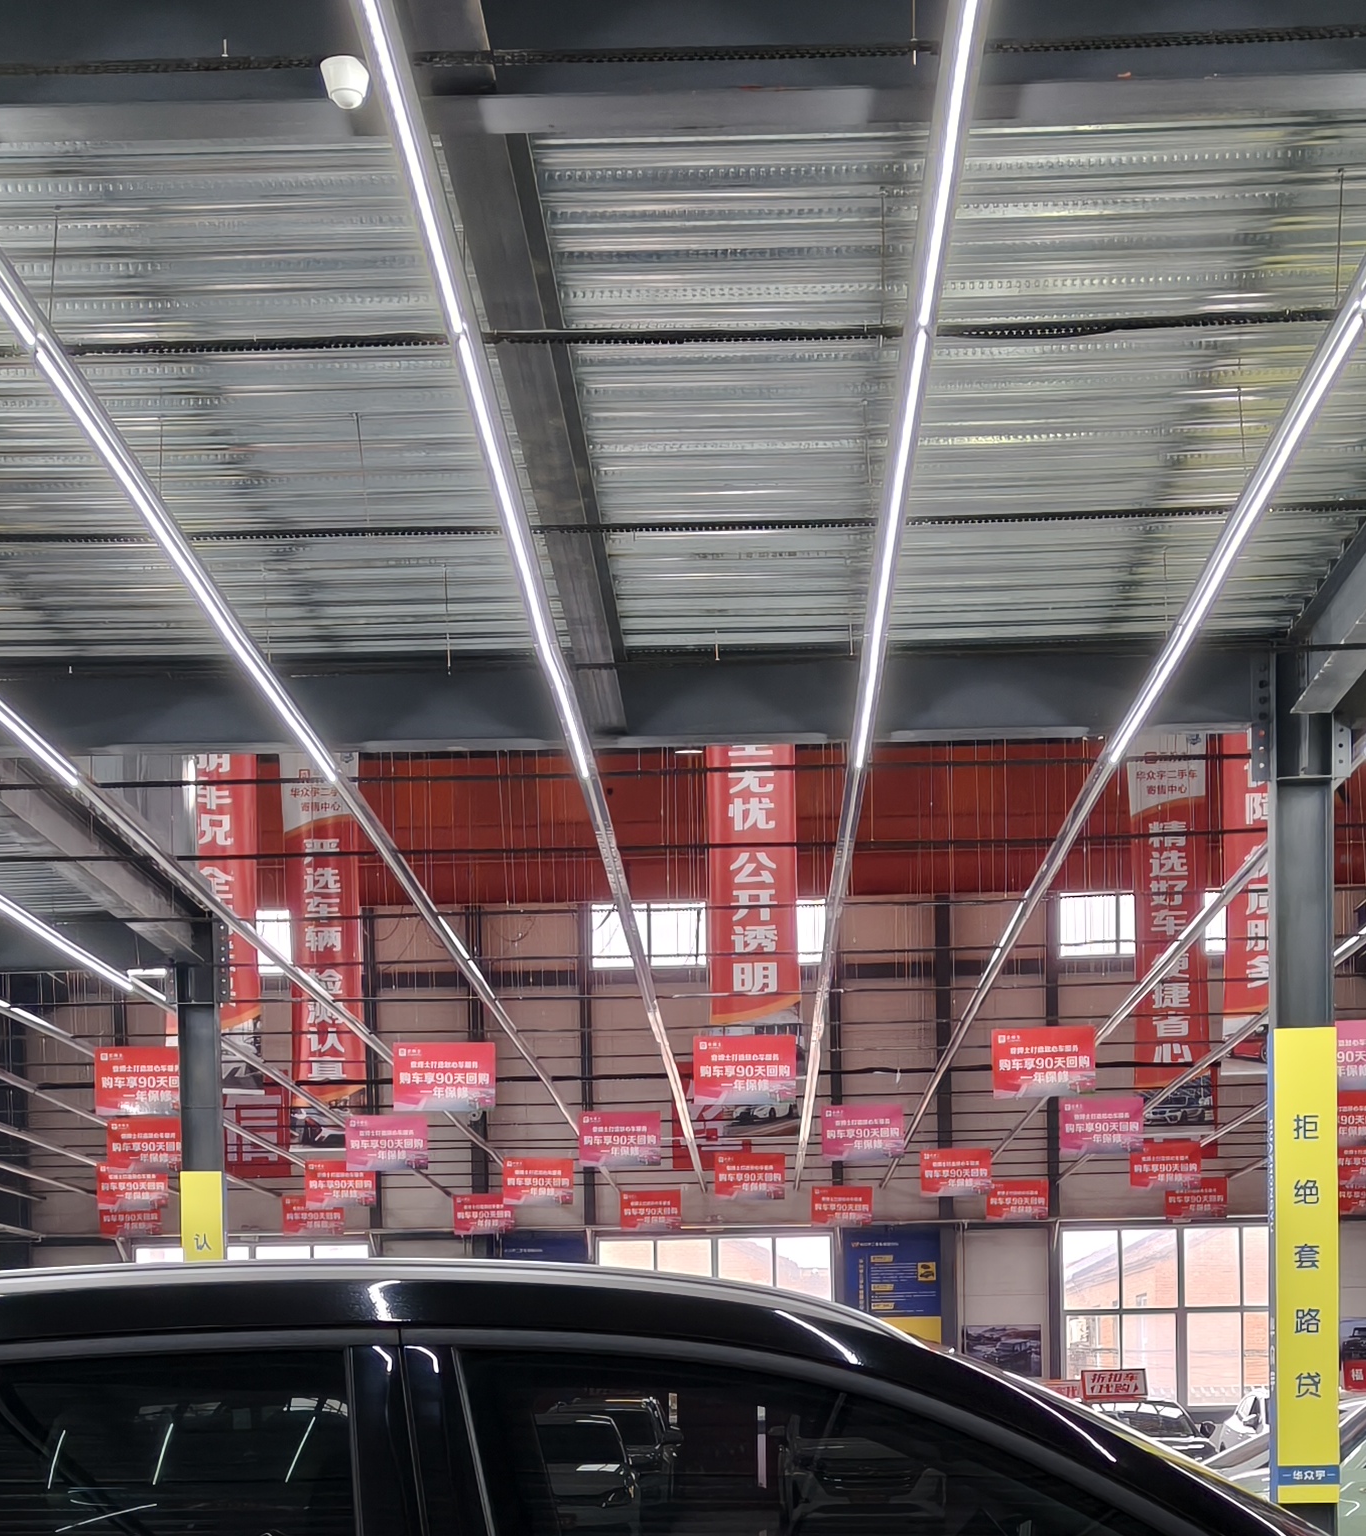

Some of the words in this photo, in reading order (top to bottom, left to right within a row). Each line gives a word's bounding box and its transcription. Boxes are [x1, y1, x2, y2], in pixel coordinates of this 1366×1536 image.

[1148, 820, 1189, 937] 精选好车
[998, 1055, 1090, 1071] 购车享90天回购
[699, 1065, 791, 1078] 购车享90天回购
[1020, 1071, 1069, 1083] 一年保修
[399, 1072, 490, 1085] 购车享90天回购
[721, 1079, 771, 1091] 一年保修
[419, 1086, 469, 1099] 一年保修
[1064, 1121, 1140, 1133] 购车享90天回购
[826, 1128, 900, 1139] 购车享90天回购
[350, 1139, 424, 1150] 购车享90天回购
[583, 1135, 657, 1145] 购车享90天回购
[924, 1169, 988, 1178] 购车享90天回购
[193, 1233, 212, 1251] 认
[1293, 1114, 1322, 1399] 拒绝套路贷
[1292, 1470, 1326, 1481] 华众宇
